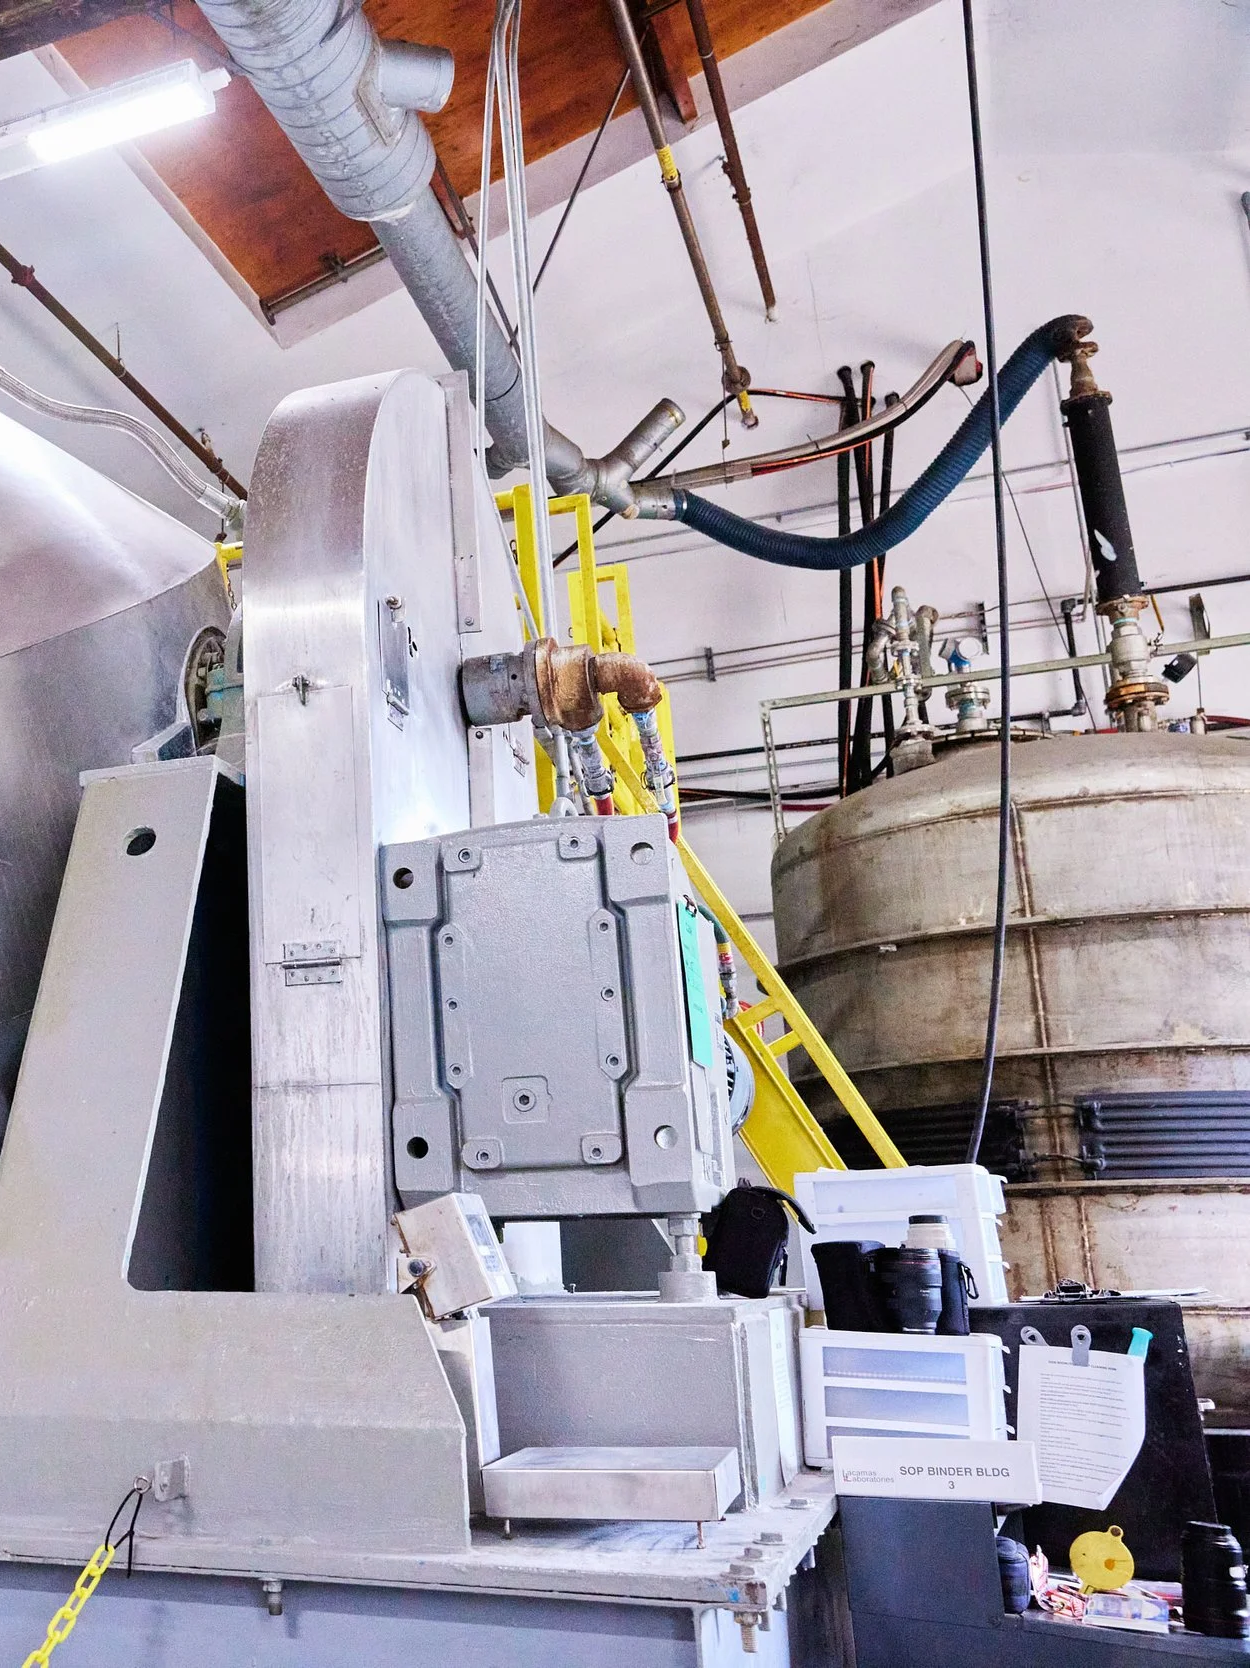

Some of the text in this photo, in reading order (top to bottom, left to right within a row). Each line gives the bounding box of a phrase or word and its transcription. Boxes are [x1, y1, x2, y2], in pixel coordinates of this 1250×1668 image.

[900, 1466, 1010, 1478] SOP BINDER BLDG
[948, 1480, 955, 1490] 3
